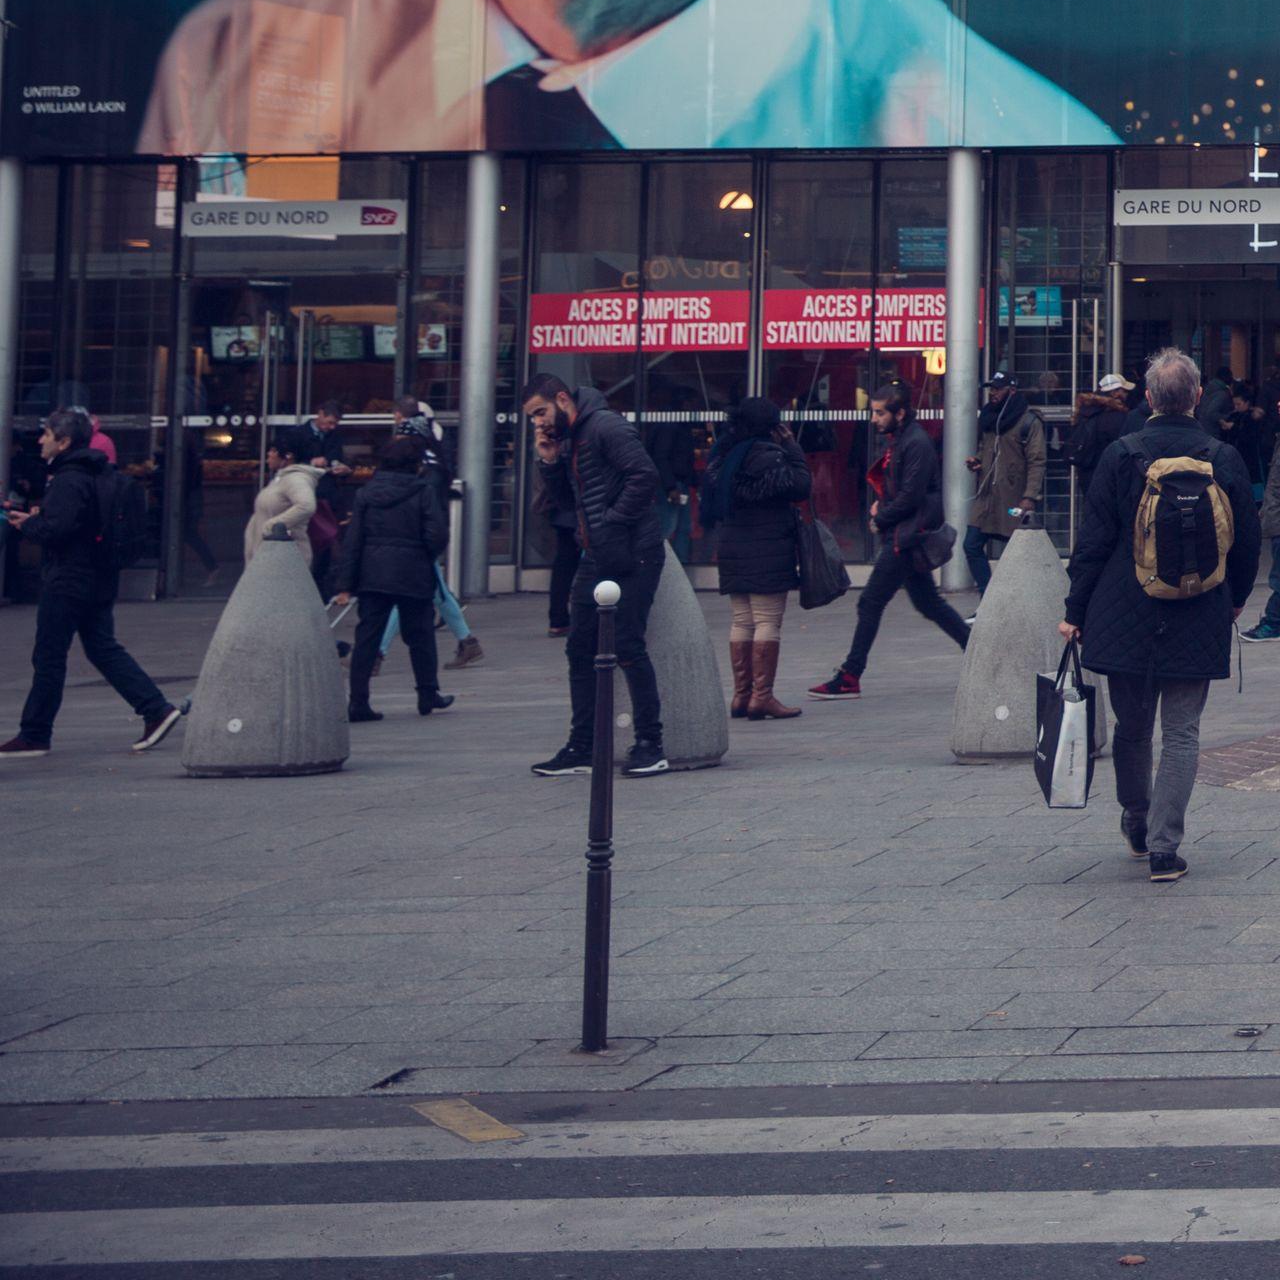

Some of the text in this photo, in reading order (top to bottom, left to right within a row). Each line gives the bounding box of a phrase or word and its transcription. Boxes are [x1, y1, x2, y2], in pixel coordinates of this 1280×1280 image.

[23, 85, 81, 98] UNTITLED
[34, 101, 87, 114] WILLIAM
[1123, 199, 1261, 214] GARE DU NORD
[191, 209, 329, 225] GARE DU NORD
[362, 213, 397, 224] SNCF
[568, 298, 623, 322] ACCES
[802, 293, 946, 318] ACCES POMPIERS
[671, 321, 746, 345] INTERDIT
[766, 319, 903, 344] STATIONNEMENT
